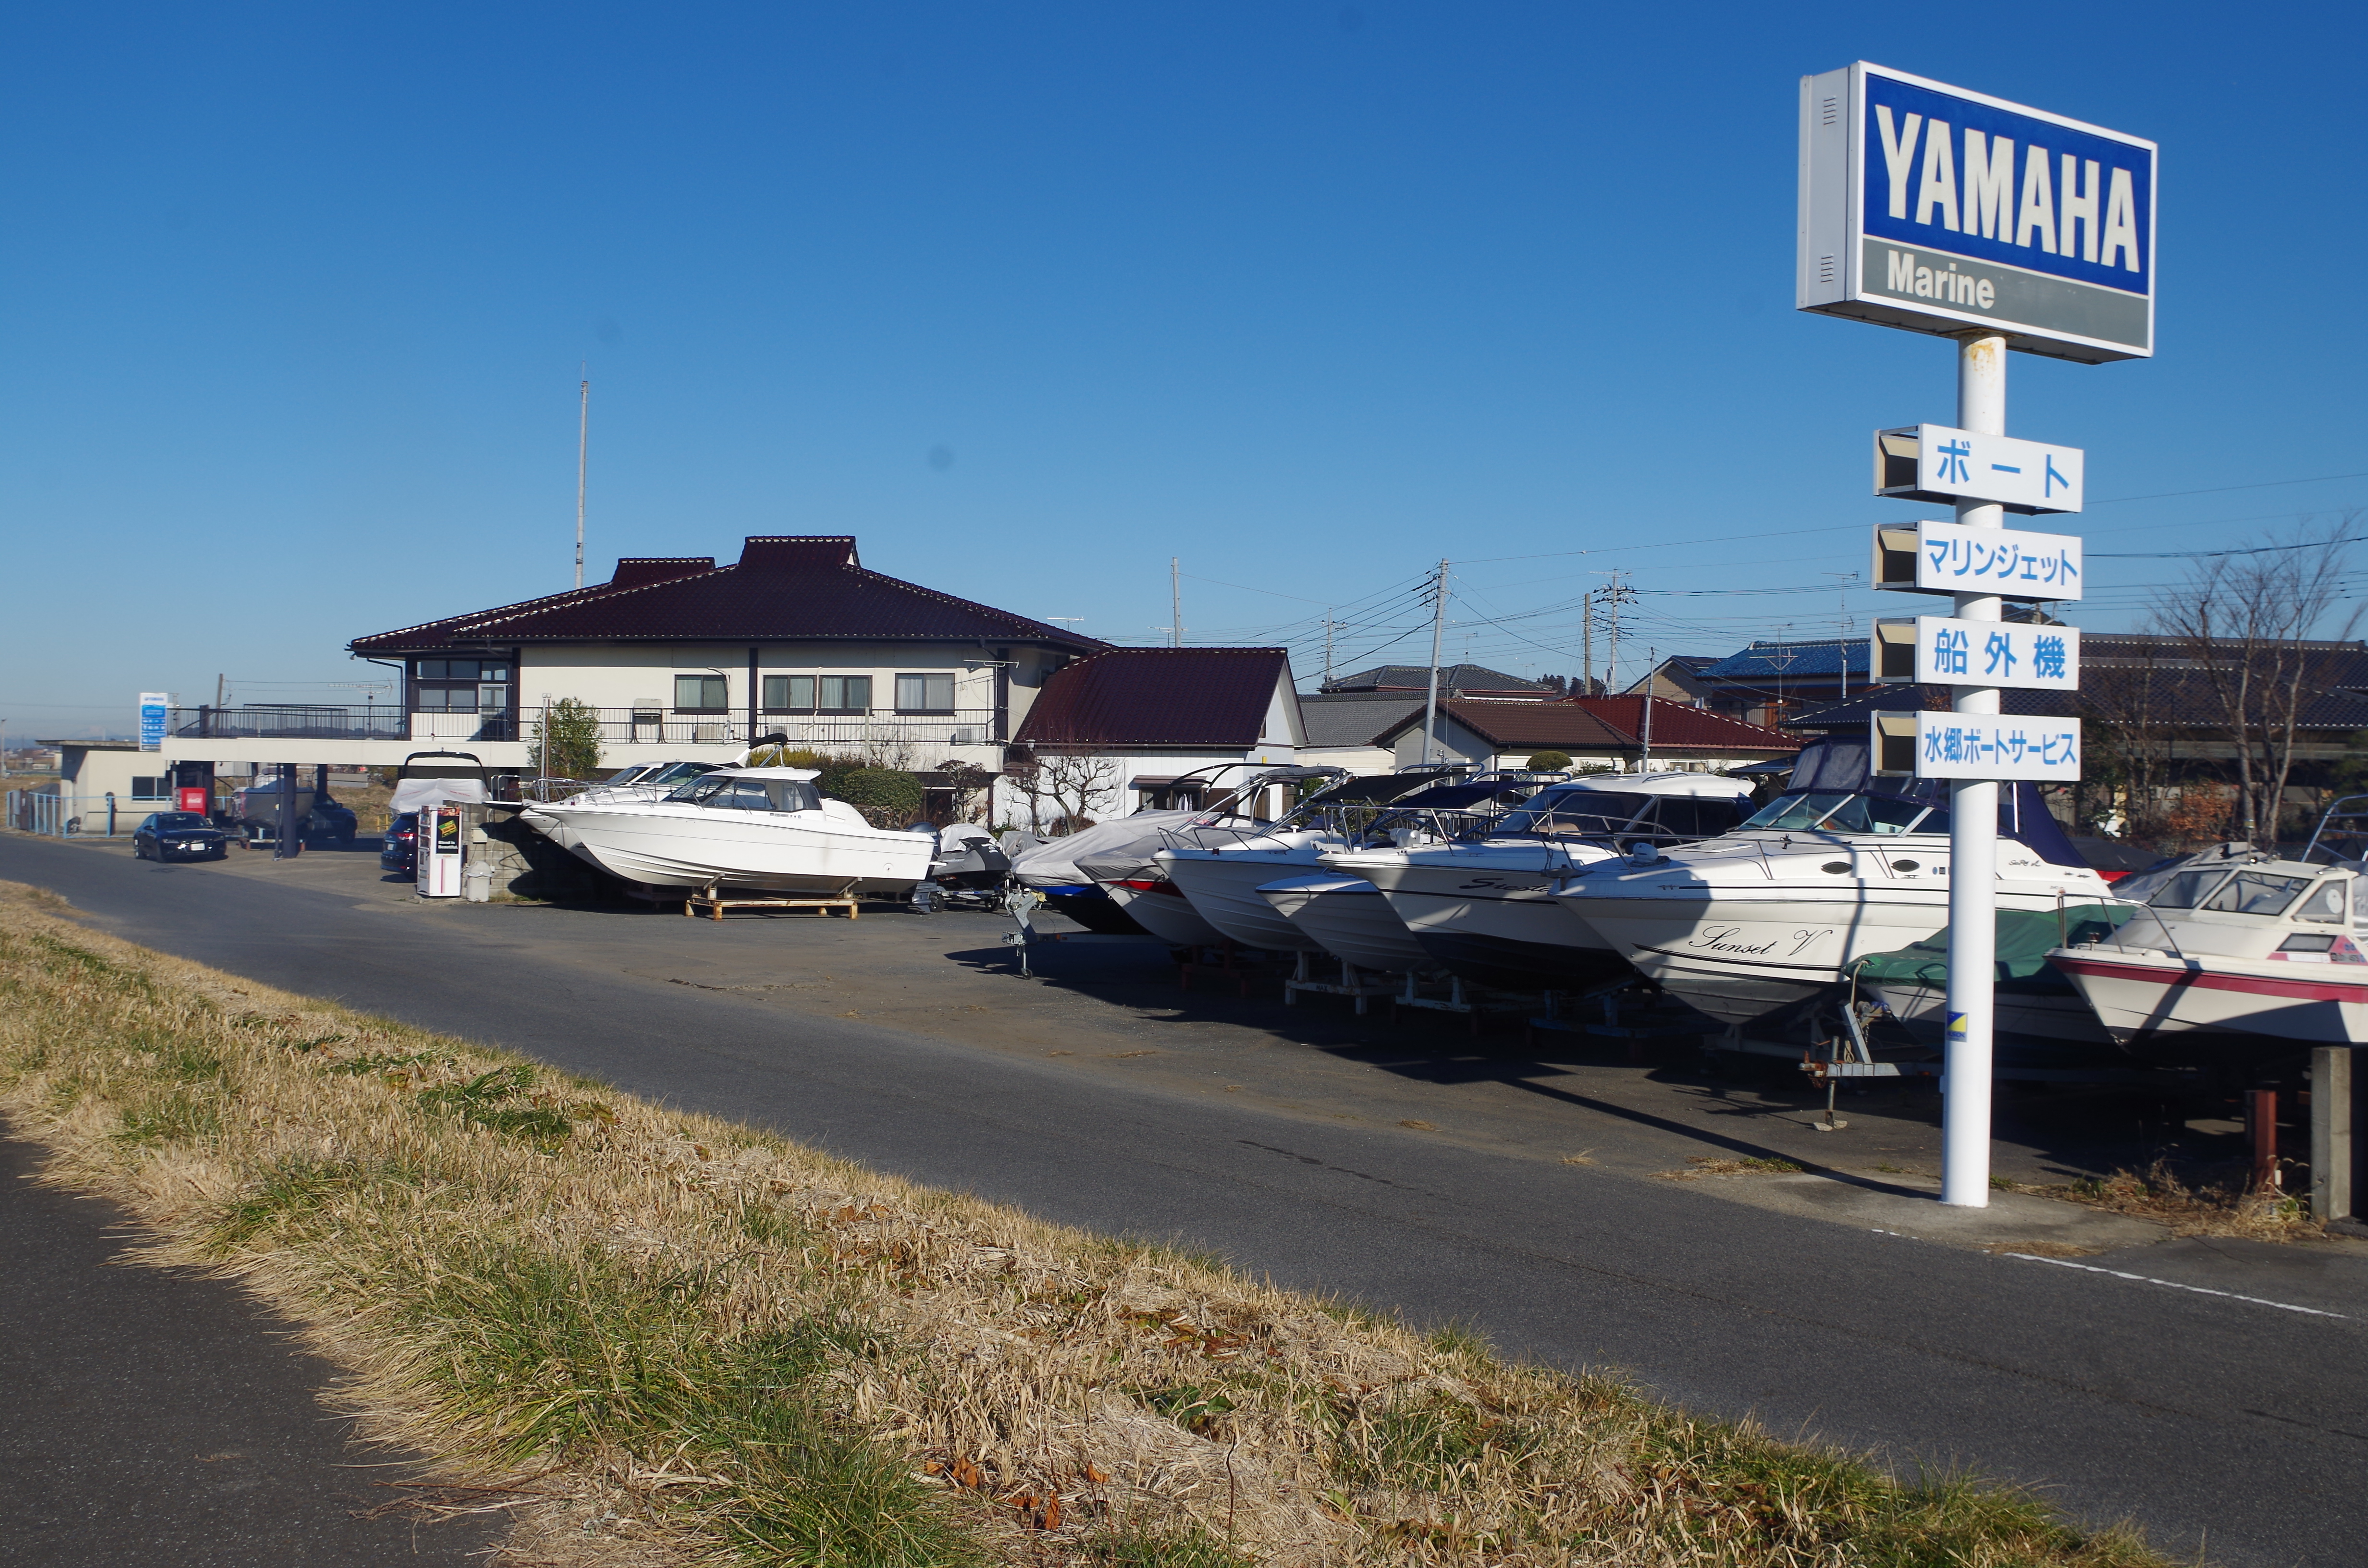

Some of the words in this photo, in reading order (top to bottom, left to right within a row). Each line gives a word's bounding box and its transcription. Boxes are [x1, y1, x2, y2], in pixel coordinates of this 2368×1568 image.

[1875, 104, 2139, 273] YAMAHA
[1887, 249, 1996, 309] Marine
[1937, 439, 2070, 498] ボート
[1925, 539, 2078, 586] マリンジェット
[1934, 627, 2066, 679] 船外機
[1924, 726, 2077, 766] 水郷ボートサービス
[1688, 925, 1778, 955] Sunset
